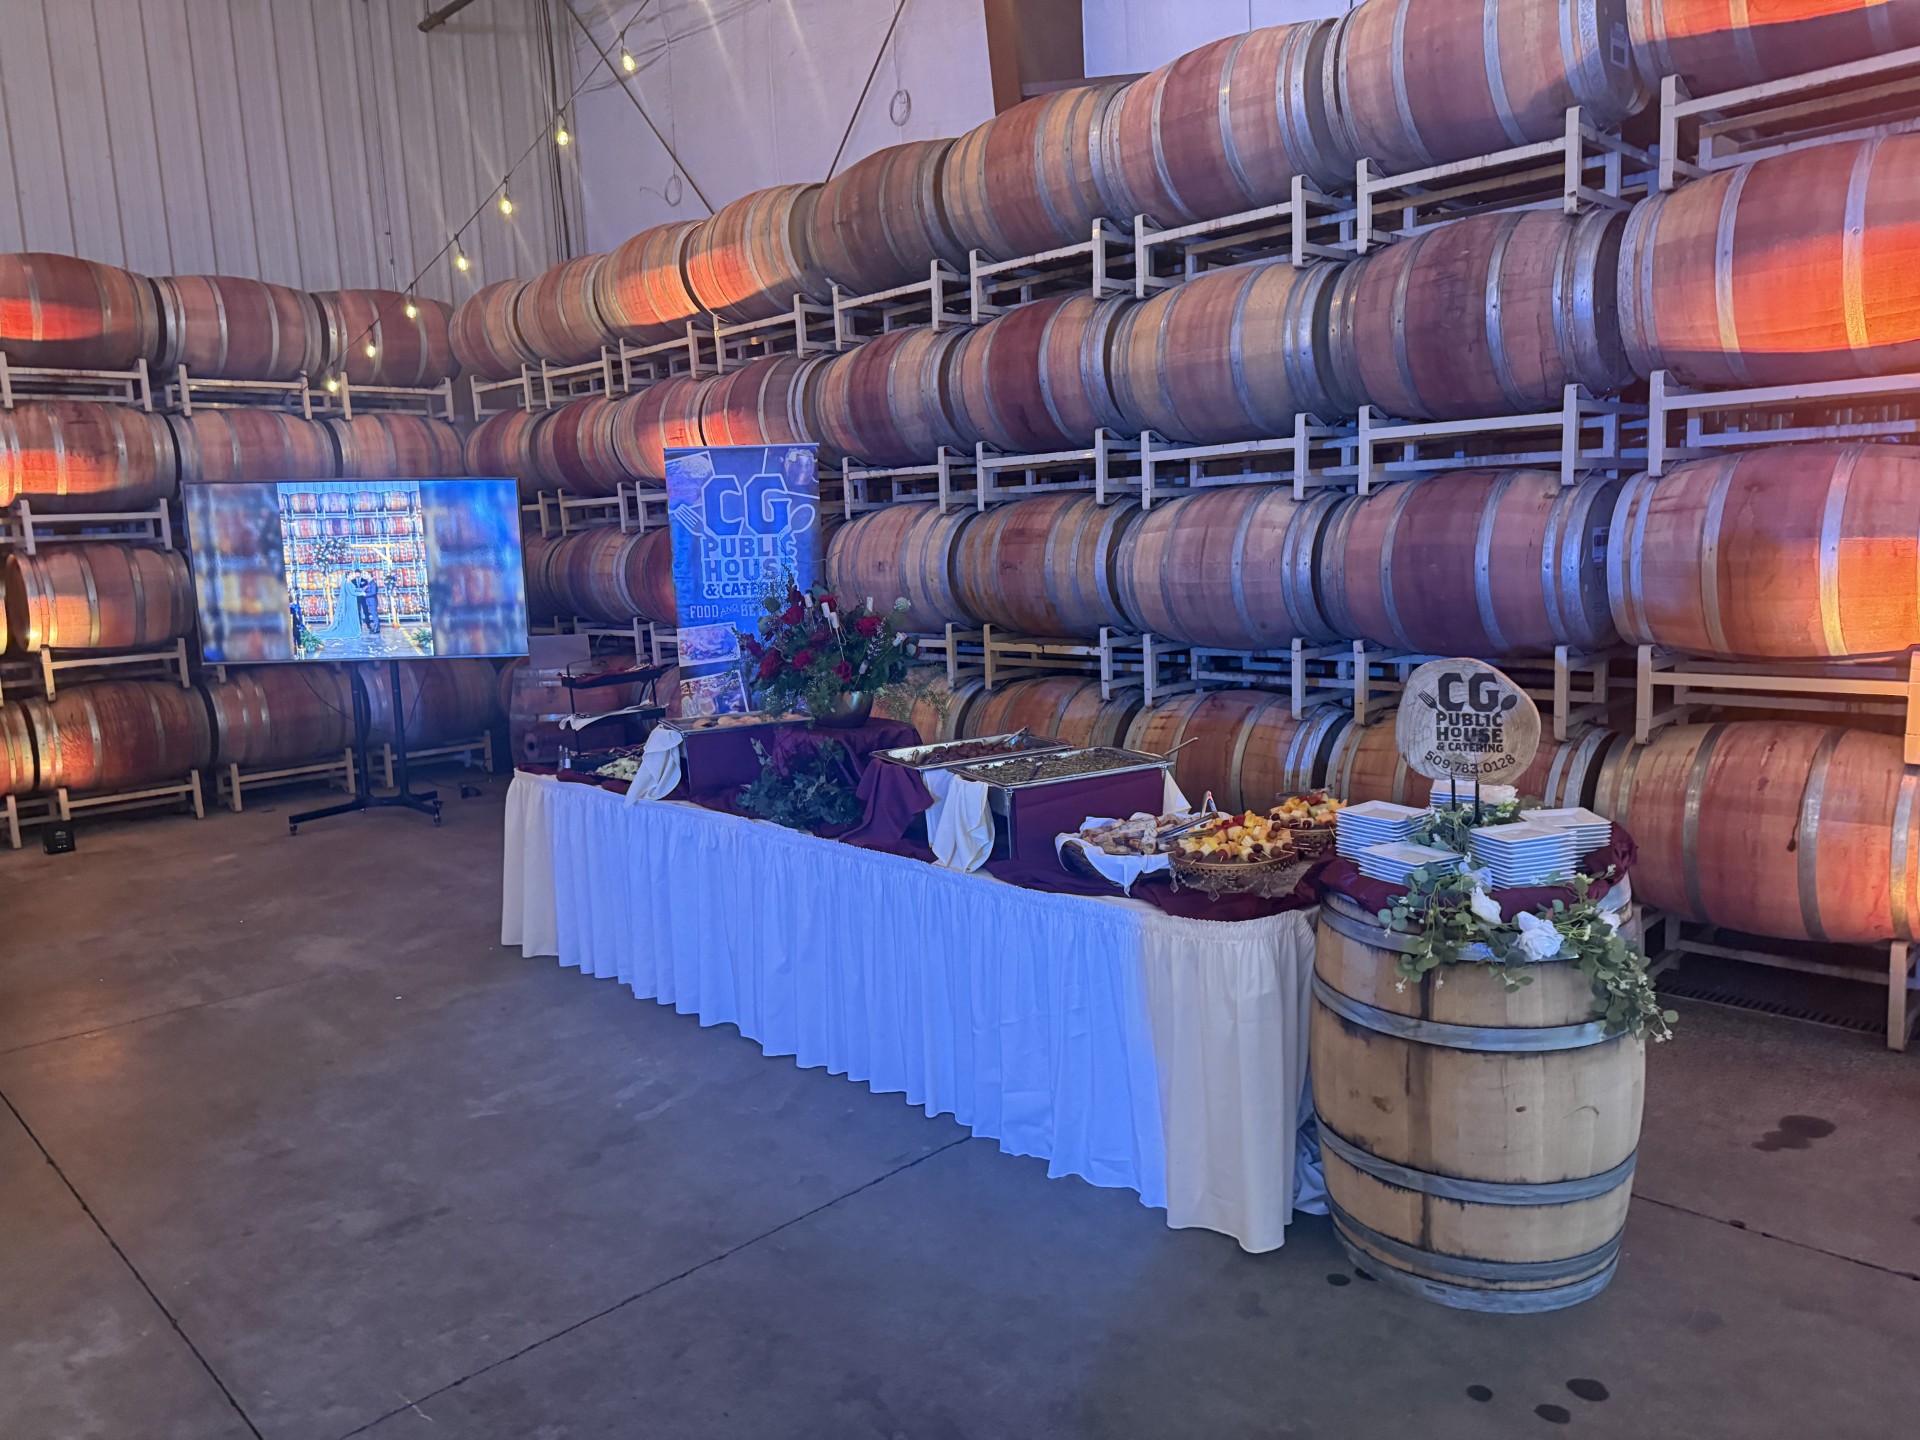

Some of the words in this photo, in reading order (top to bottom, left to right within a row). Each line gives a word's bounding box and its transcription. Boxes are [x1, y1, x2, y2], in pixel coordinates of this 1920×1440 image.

[701, 474, 792, 536] CG
[703, 535, 796, 558] PUBLIC
[706, 584, 719, 596] &
[690, 605, 719, 618] FOOD
[1438, 673, 1500, 712] CG
[1436, 711, 1503, 727] PUBLIC
[1436, 727, 1503, 743] HOUSE
[1436, 742, 1445, 752] &
[1448, 743, 1504, 753] CATERING
